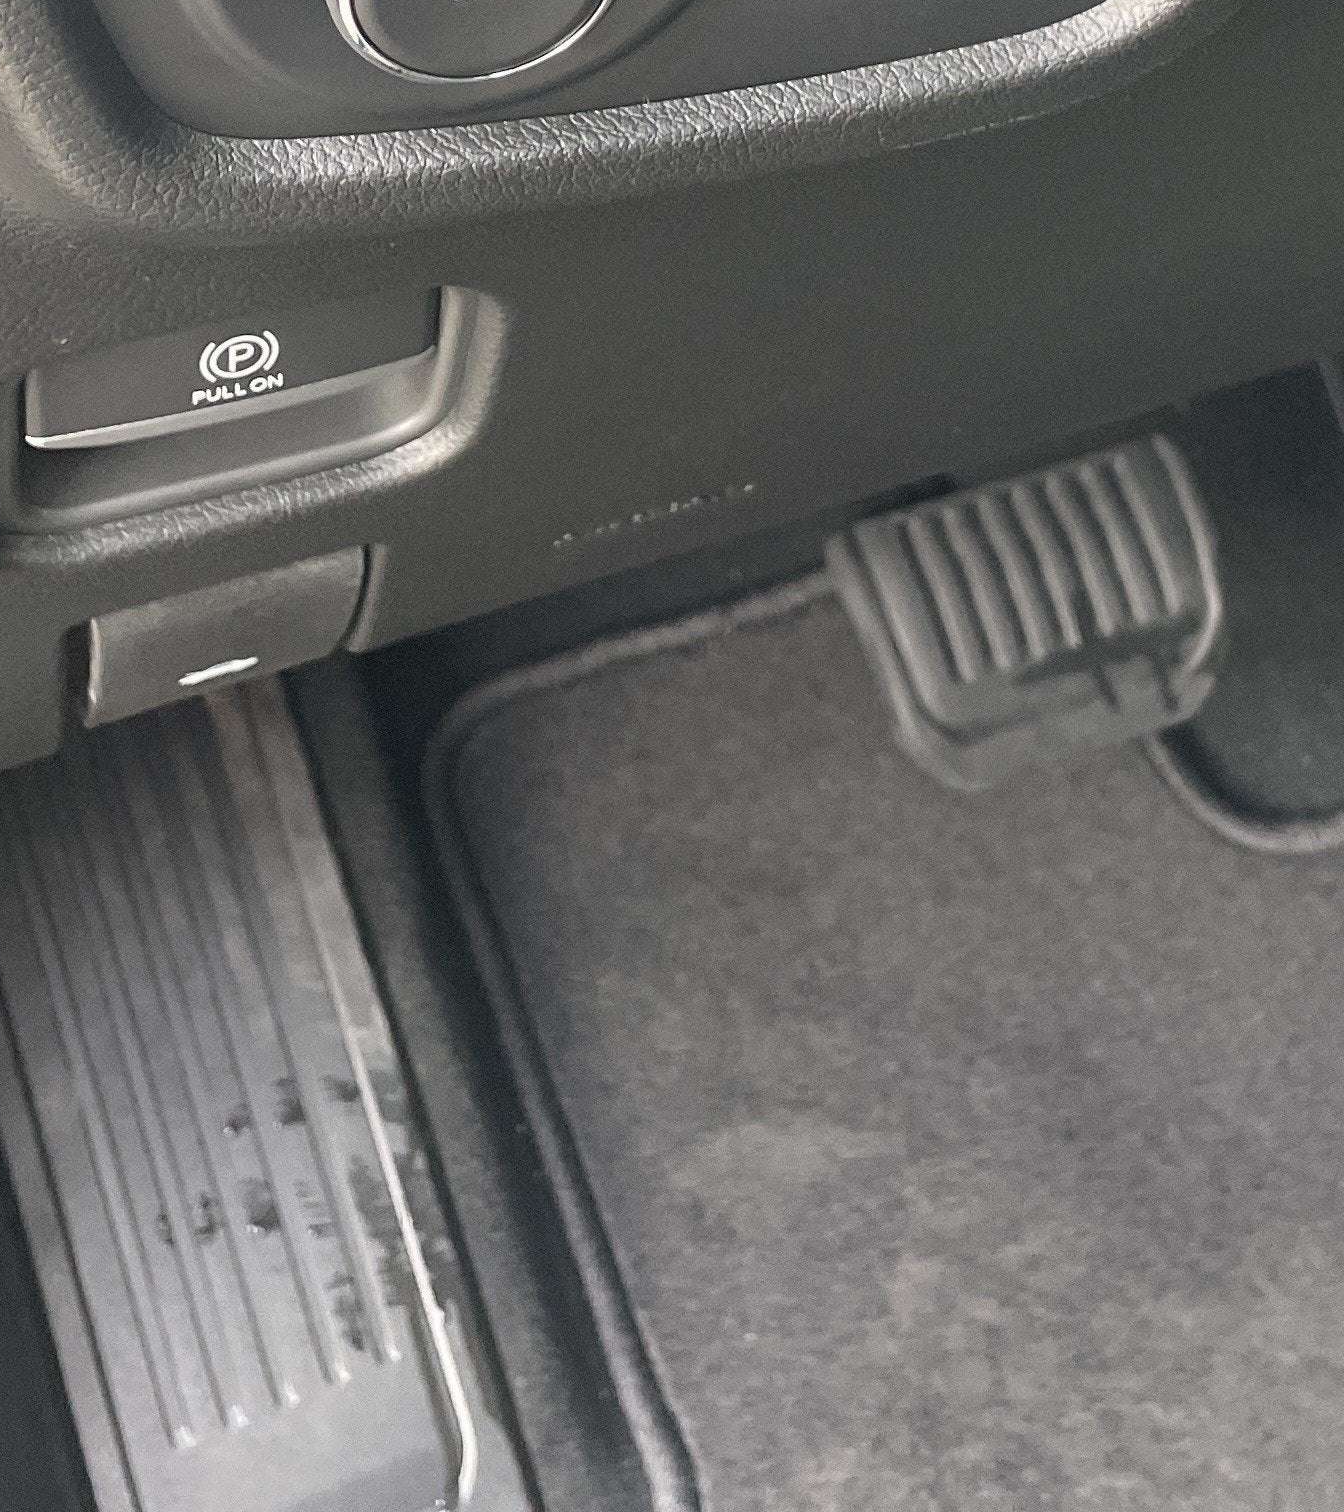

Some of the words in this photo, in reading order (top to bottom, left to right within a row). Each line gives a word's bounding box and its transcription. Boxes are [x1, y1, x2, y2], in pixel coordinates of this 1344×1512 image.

[227, 342, 255, 373] P
[191, 382, 247, 406] PULL
[249, 372, 284, 393] ON
